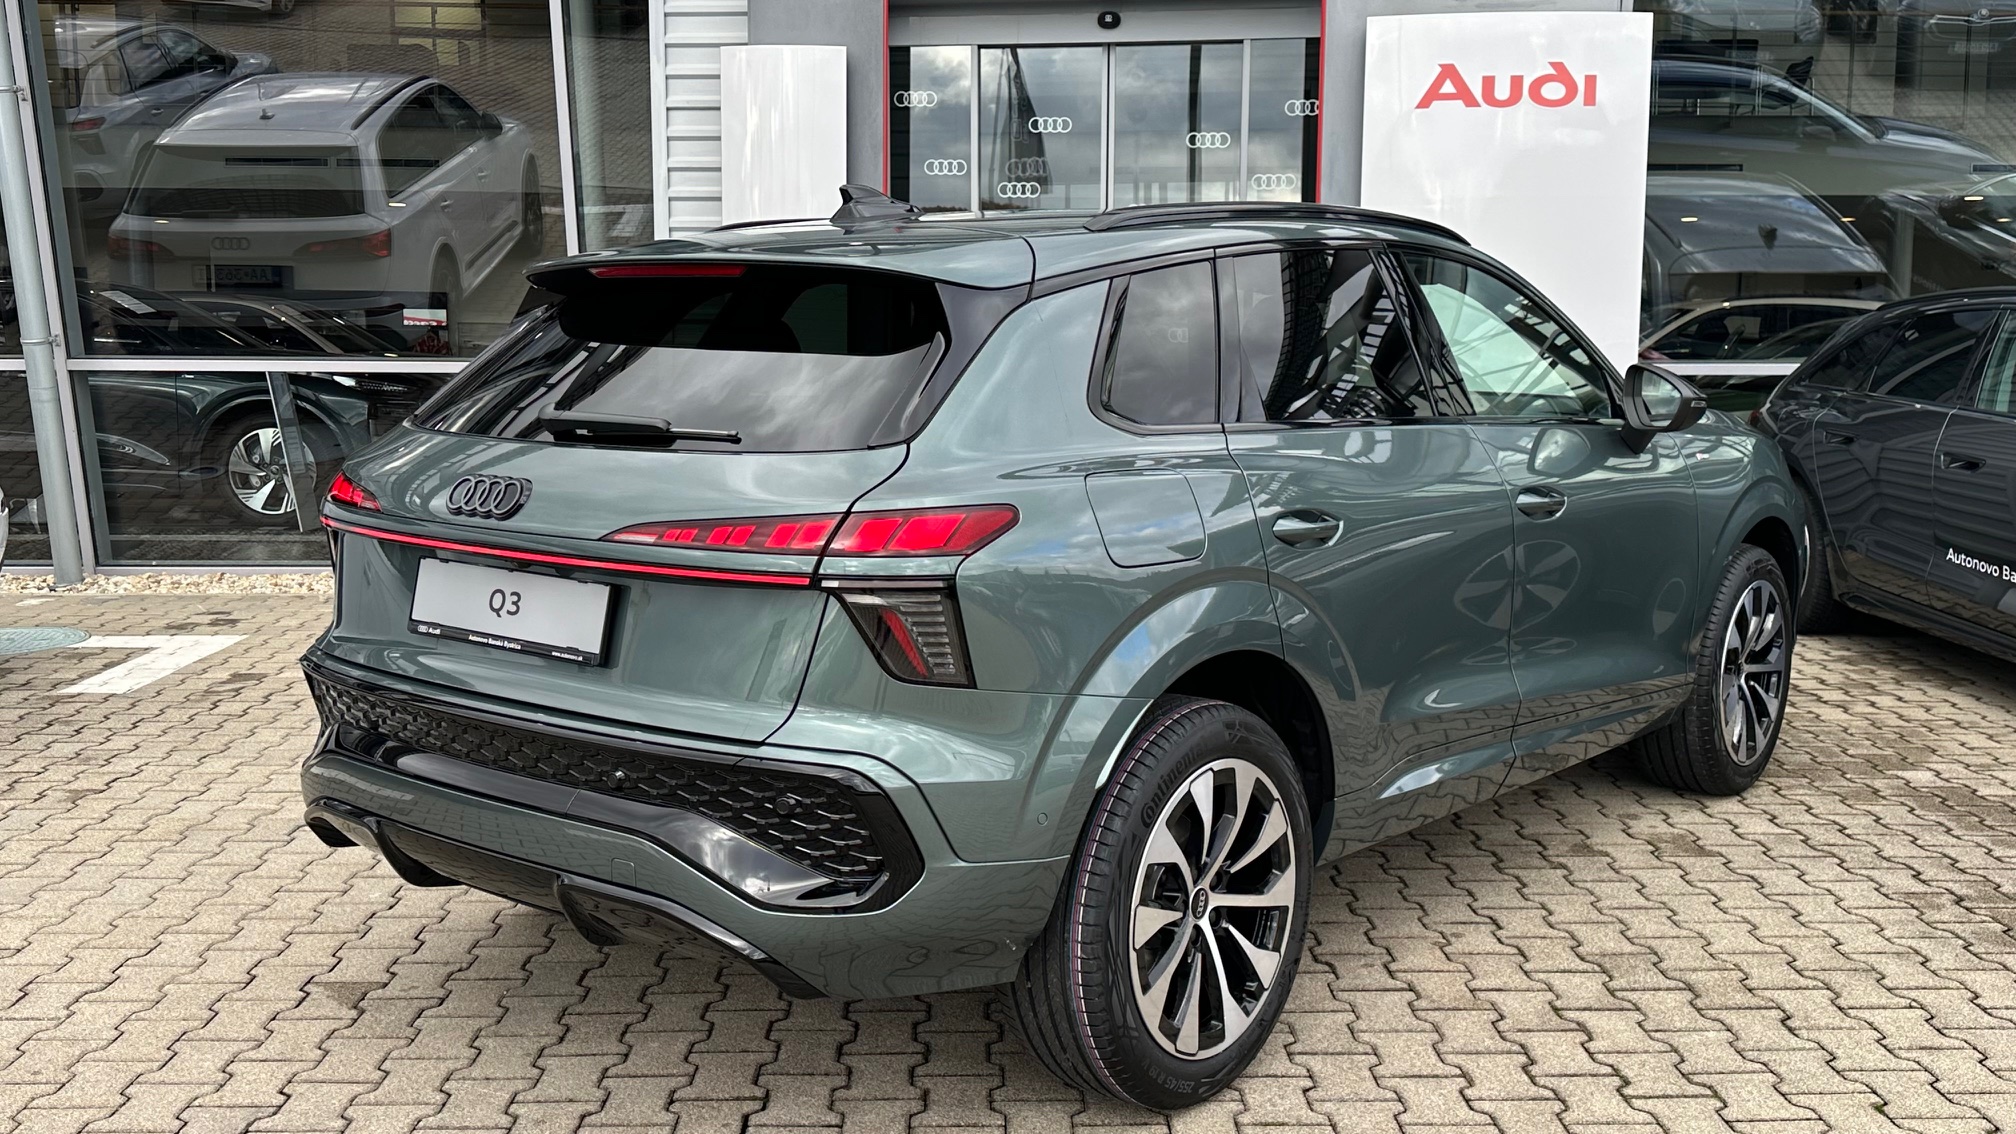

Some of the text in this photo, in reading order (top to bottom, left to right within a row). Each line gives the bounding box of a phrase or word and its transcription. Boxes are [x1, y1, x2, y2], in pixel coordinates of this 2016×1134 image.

[1414, 61, 1597, 109] Audi
[1946, 547, 2000, 577] Autonovo
[488, 588, 522, 618] Q3
[428, 627, 441, 635] Audi
[468, 634, 488, 643] Autonovo
[504, 640, 521, 649] Bystrica
[1165, 1076, 1195, 1093] 255/45
